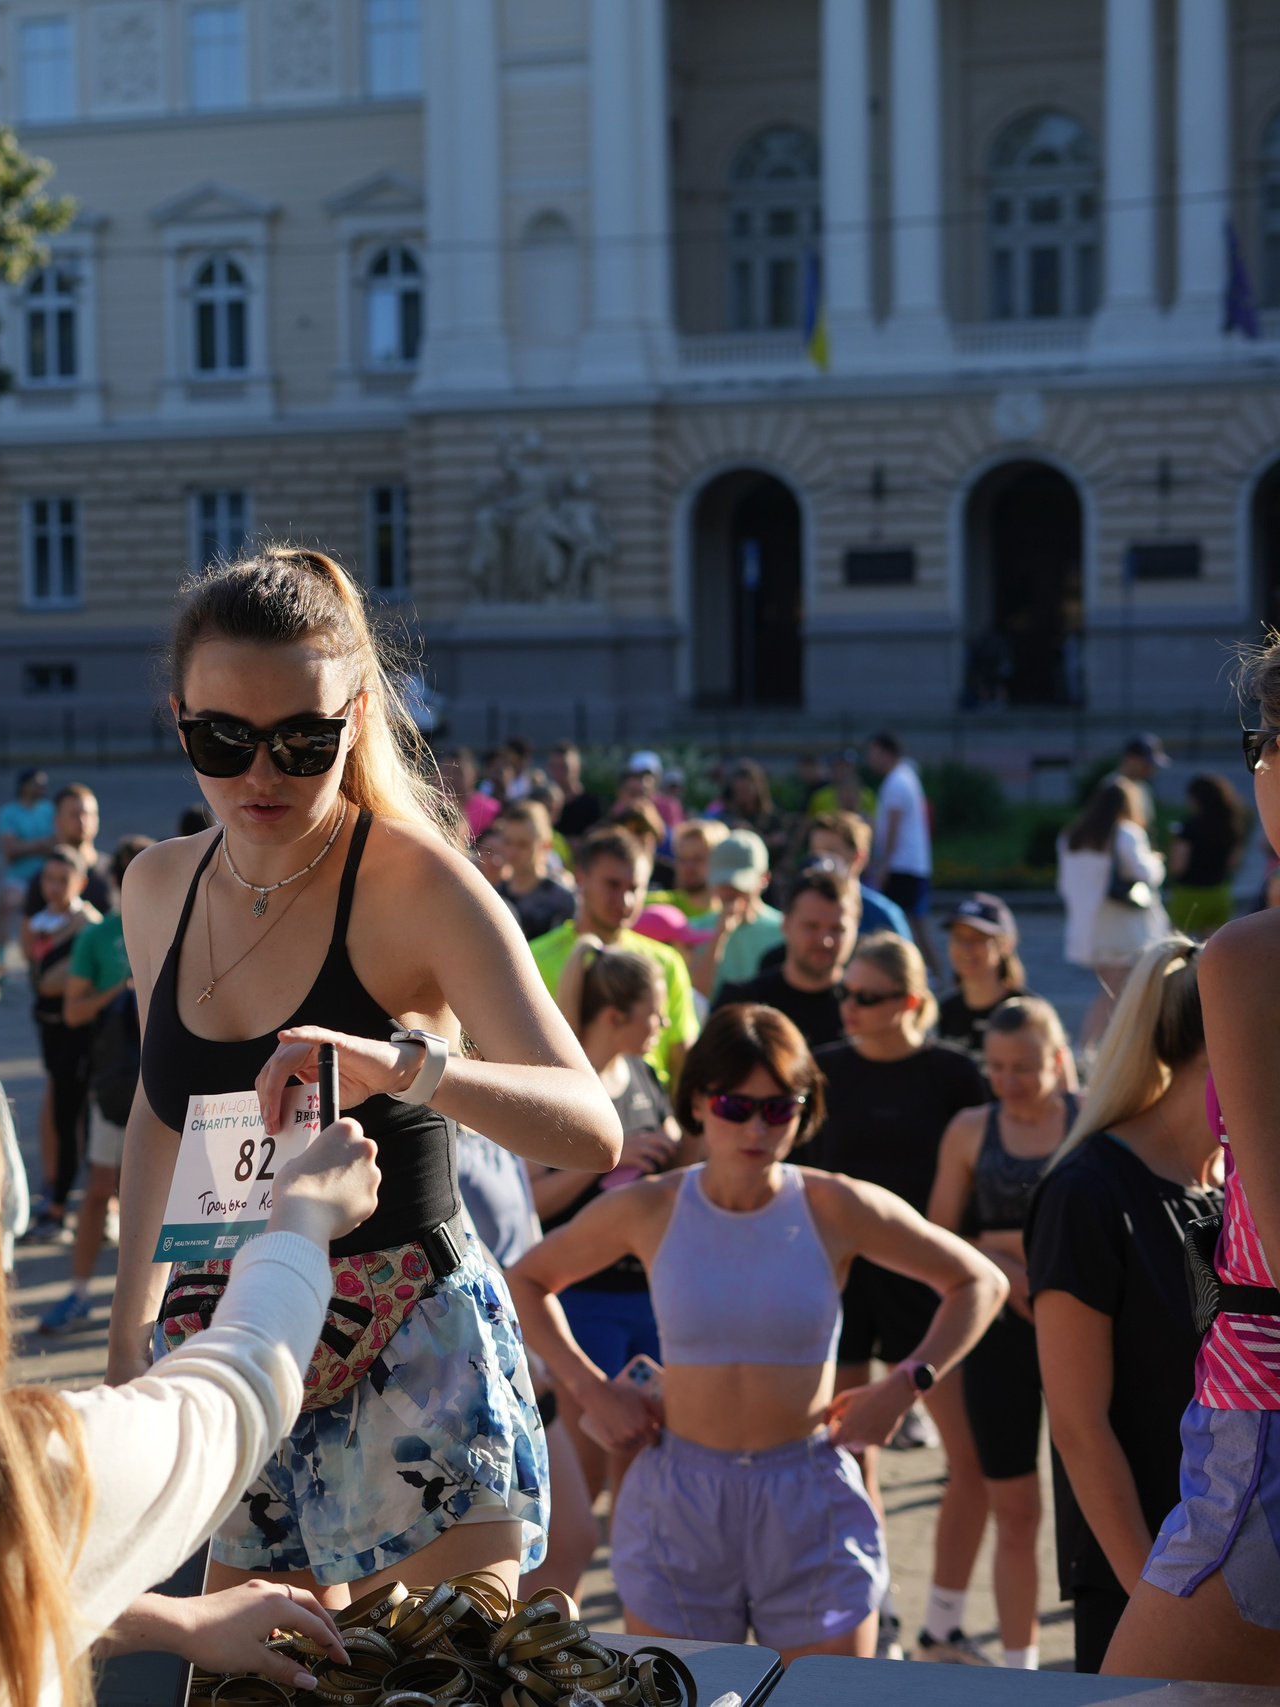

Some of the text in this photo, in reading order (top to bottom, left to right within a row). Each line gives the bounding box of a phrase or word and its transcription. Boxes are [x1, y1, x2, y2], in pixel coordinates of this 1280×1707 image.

[194, 1098, 260, 1117] BANKHOTE
[191, 1116, 240, 1131] CHARITY
[295, 1108, 321, 1124] BRON
